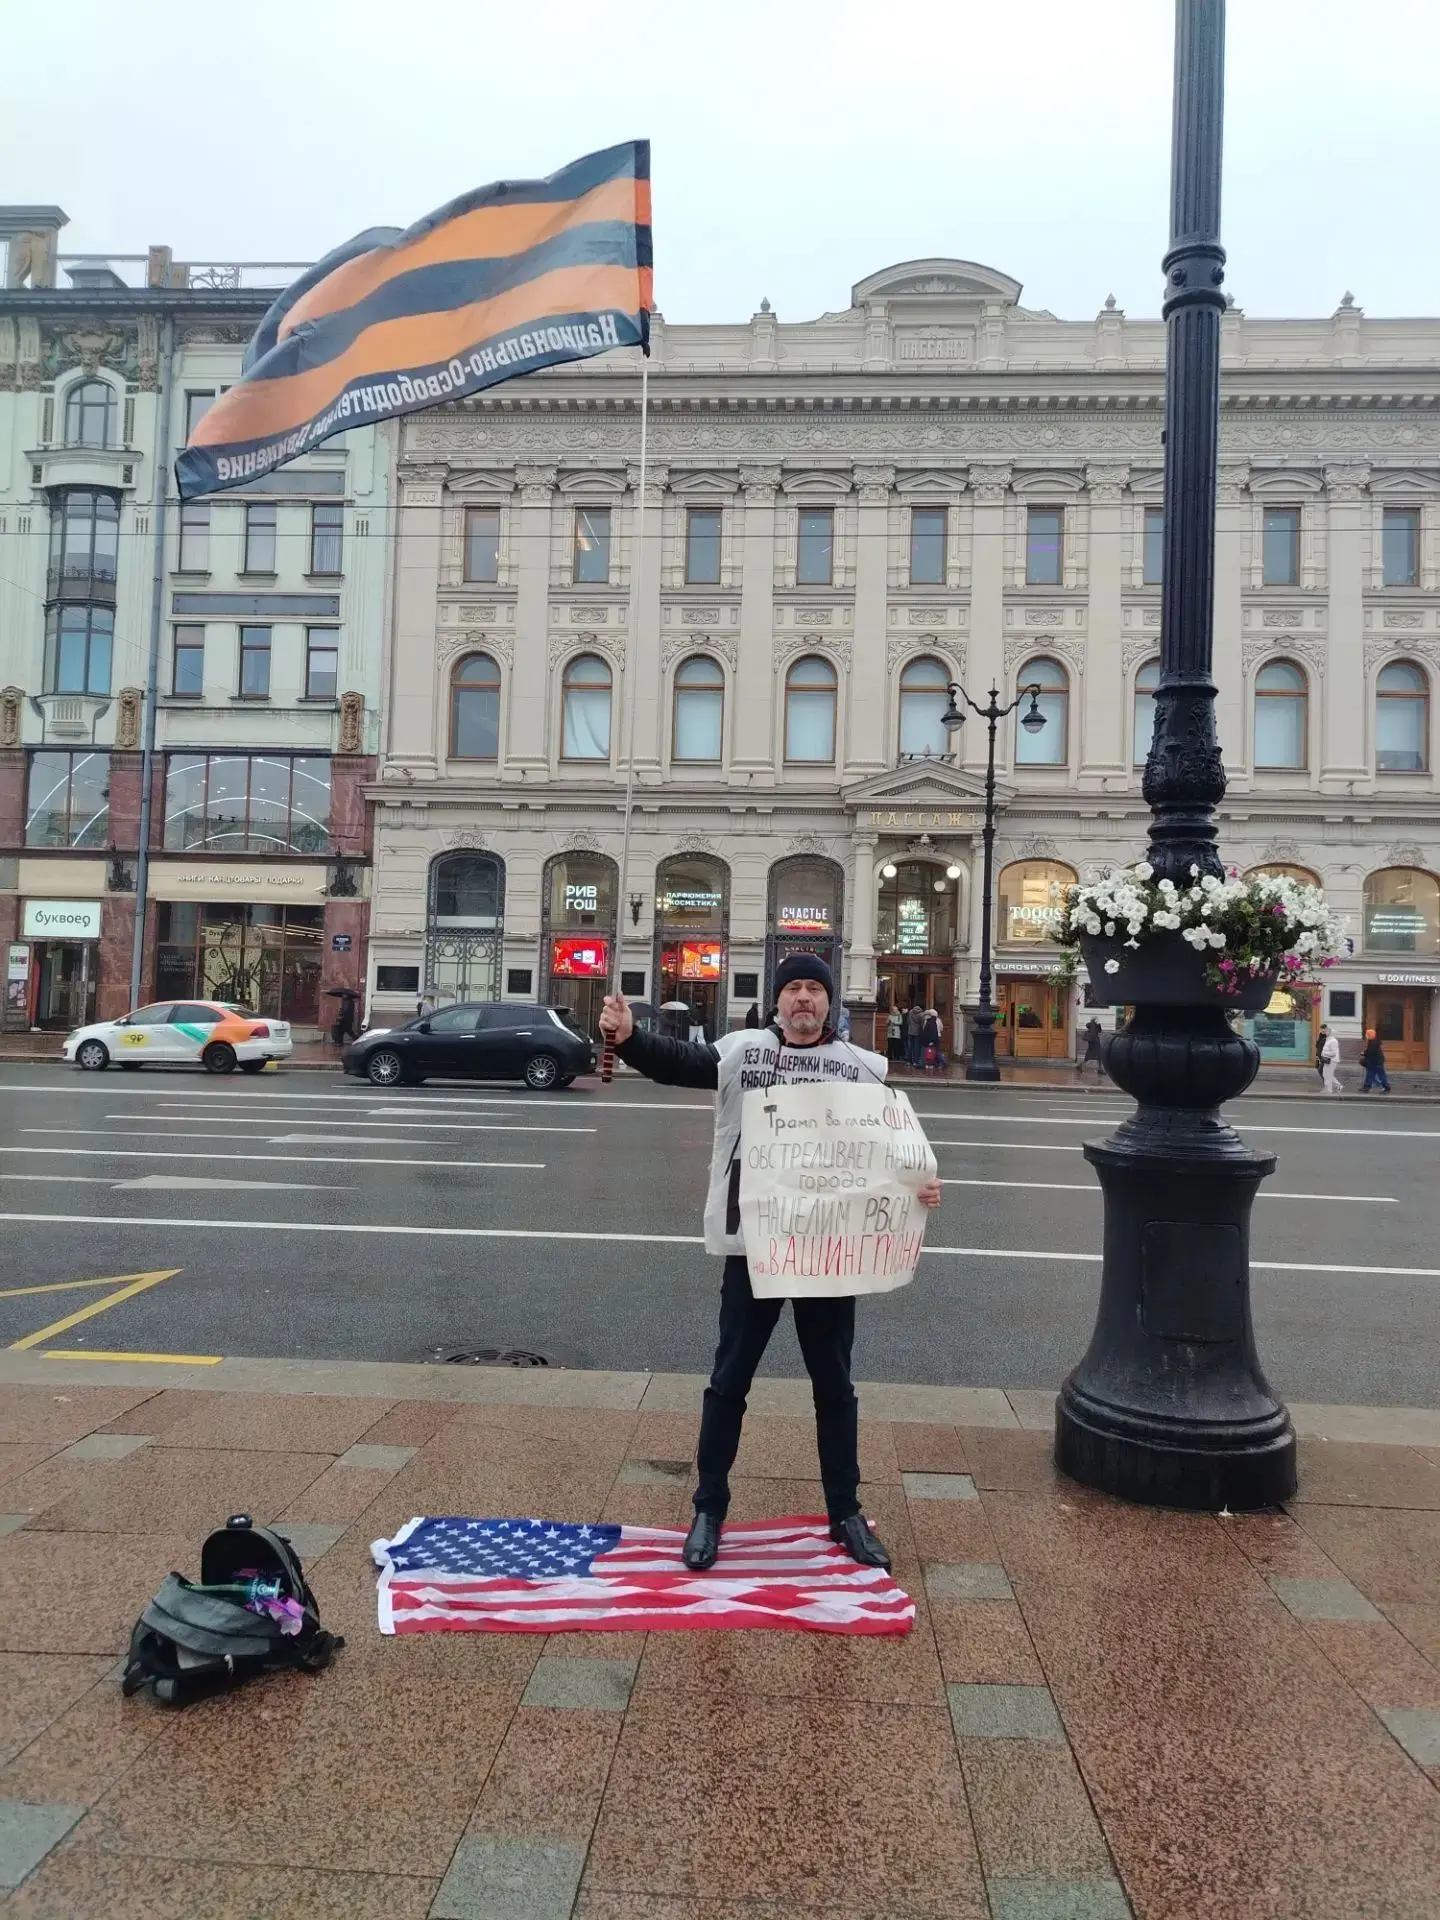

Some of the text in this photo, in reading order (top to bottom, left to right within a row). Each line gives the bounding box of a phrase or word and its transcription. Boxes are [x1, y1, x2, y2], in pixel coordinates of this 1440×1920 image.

[566, 885, 598, 897] РИВ
[566, 898, 597, 910] ГОШ
[782, 907, 828, 920] СЧАСТЬЕ
[762, 1048, 821, 1074] ПОДДЕРЖКИ
[823, 1058, 859, 1083] НАРОДА
[763, 1104, 819, 1136] Трамп
[882, 1105, 915, 1131] США
[884, 1142, 927, 1172] НАШИ
[799, 1170, 867, 1194] города
[756, 1196, 911, 1238] НАЦЕЛИМ РВСН
